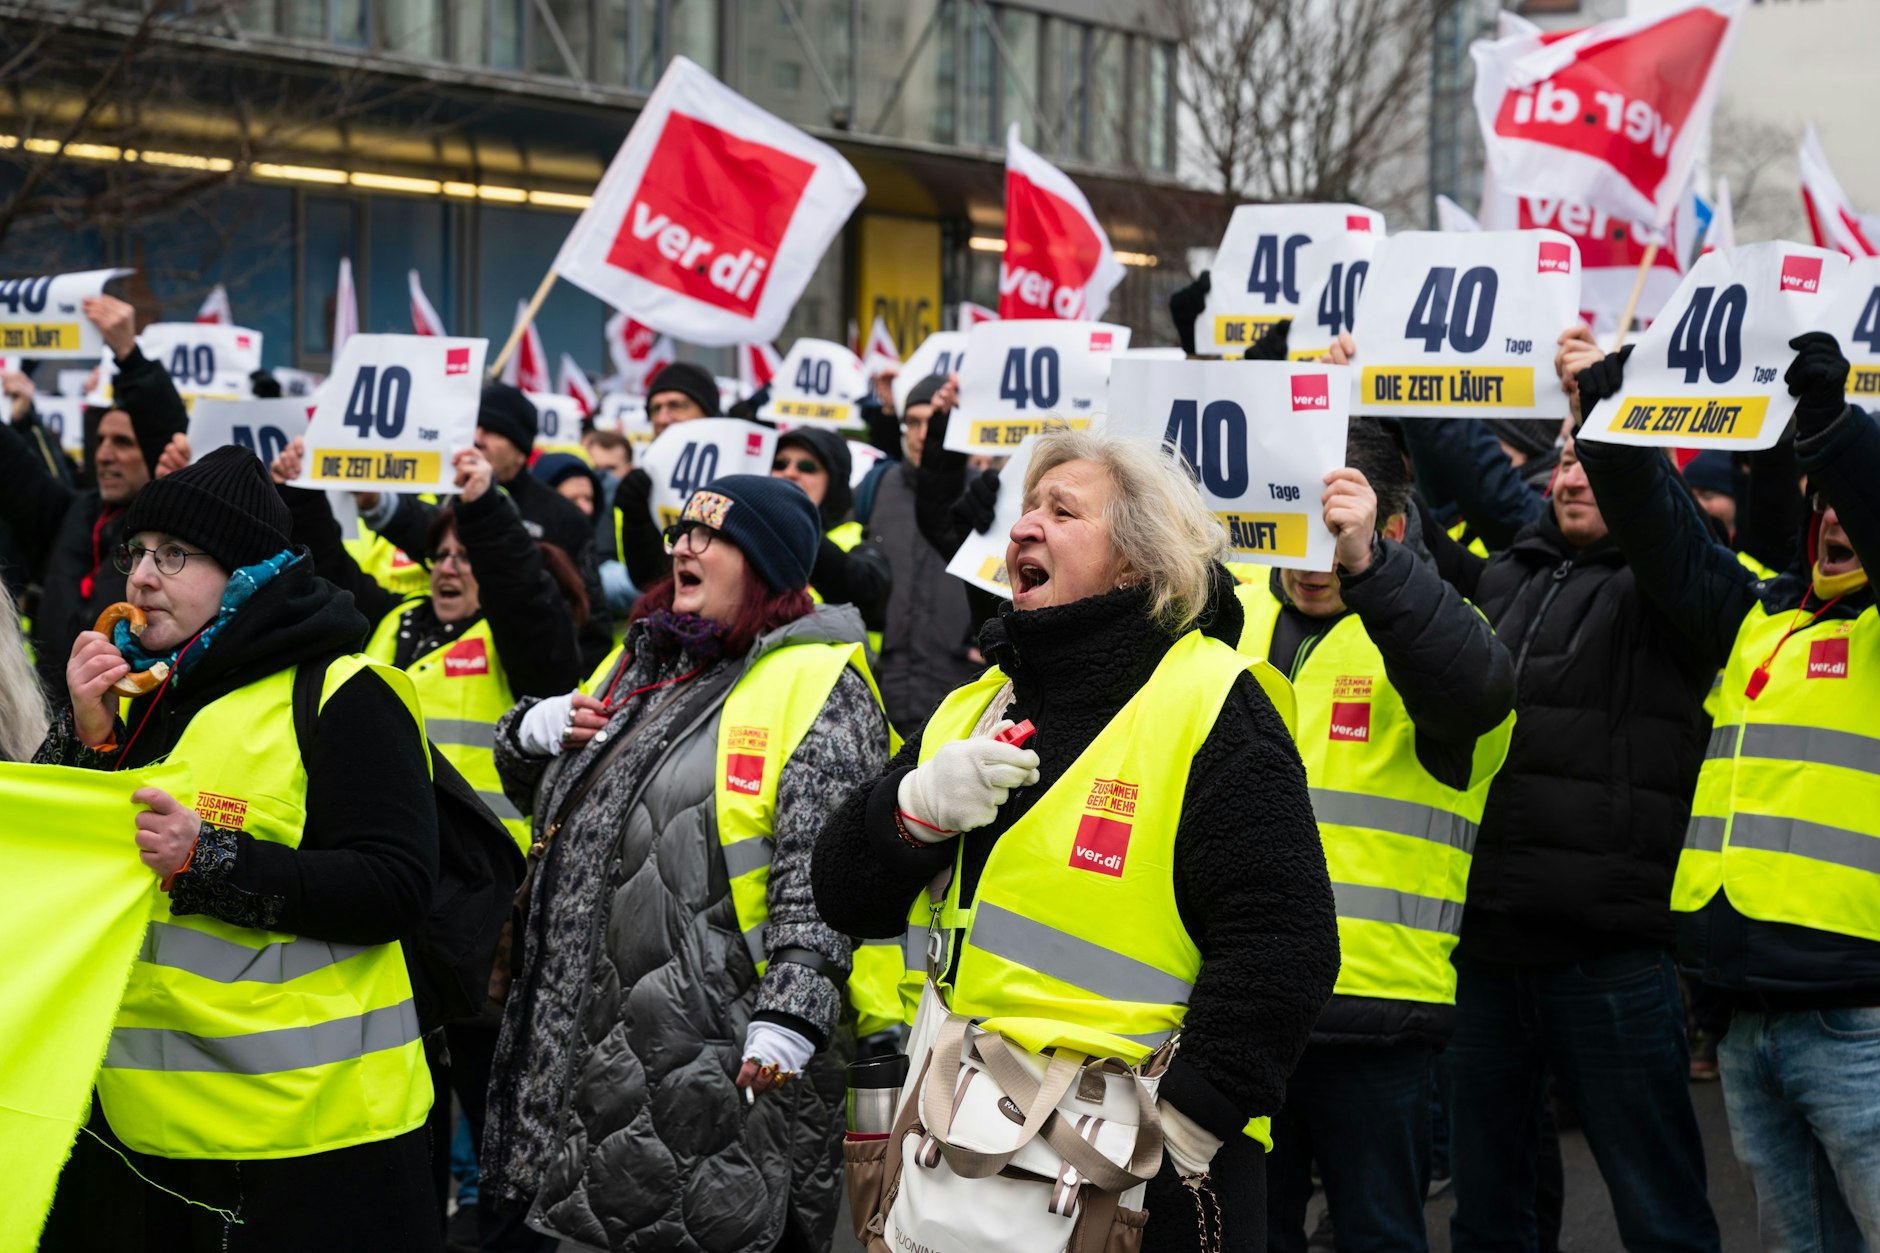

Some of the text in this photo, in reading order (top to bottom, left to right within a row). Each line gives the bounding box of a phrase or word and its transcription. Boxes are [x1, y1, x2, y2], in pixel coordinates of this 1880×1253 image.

[632, 201, 767, 301] ver.di
[1404, 266, 1498, 353] 40
[1505, 338, 1532, 355] Tage
[1667, 284, 1747, 384] 40
[171, 344, 215, 385] 40
[795, 357, 832, 395] 40
[1000, 347, 1060, 409] 40
[1753, 366, 1777, 384] Tage
[1375, 370, 1504, 402] DIE ZEIT LÄUFT
[343, 365, 412, 439] 40
[1622, 401, 1743, 433] DIE ZEIT LÄUFT
[322, 453, 418, 480] DIE ZEIT LÄUFT
[670, 442, 718, 499] 40
[1268, 483, 1300, 501] Tage
[1218, 515, 1277, 550] ÄUFT
[1810, 662, 1846, 675] ver.di
[1331, 724, 1367, 738] ver.di
[728, 774, 760, 791] ver.di
[1091, 782, 1138, 800] ZUSAMMEN
[197, 796, 247, 815] ZUSAMMEN
[1087, 794, 1136, 814] GEHT MEHR
[219, 812, 245, 827] MEHR
[1076, 845, 1122, 870] ver.di
